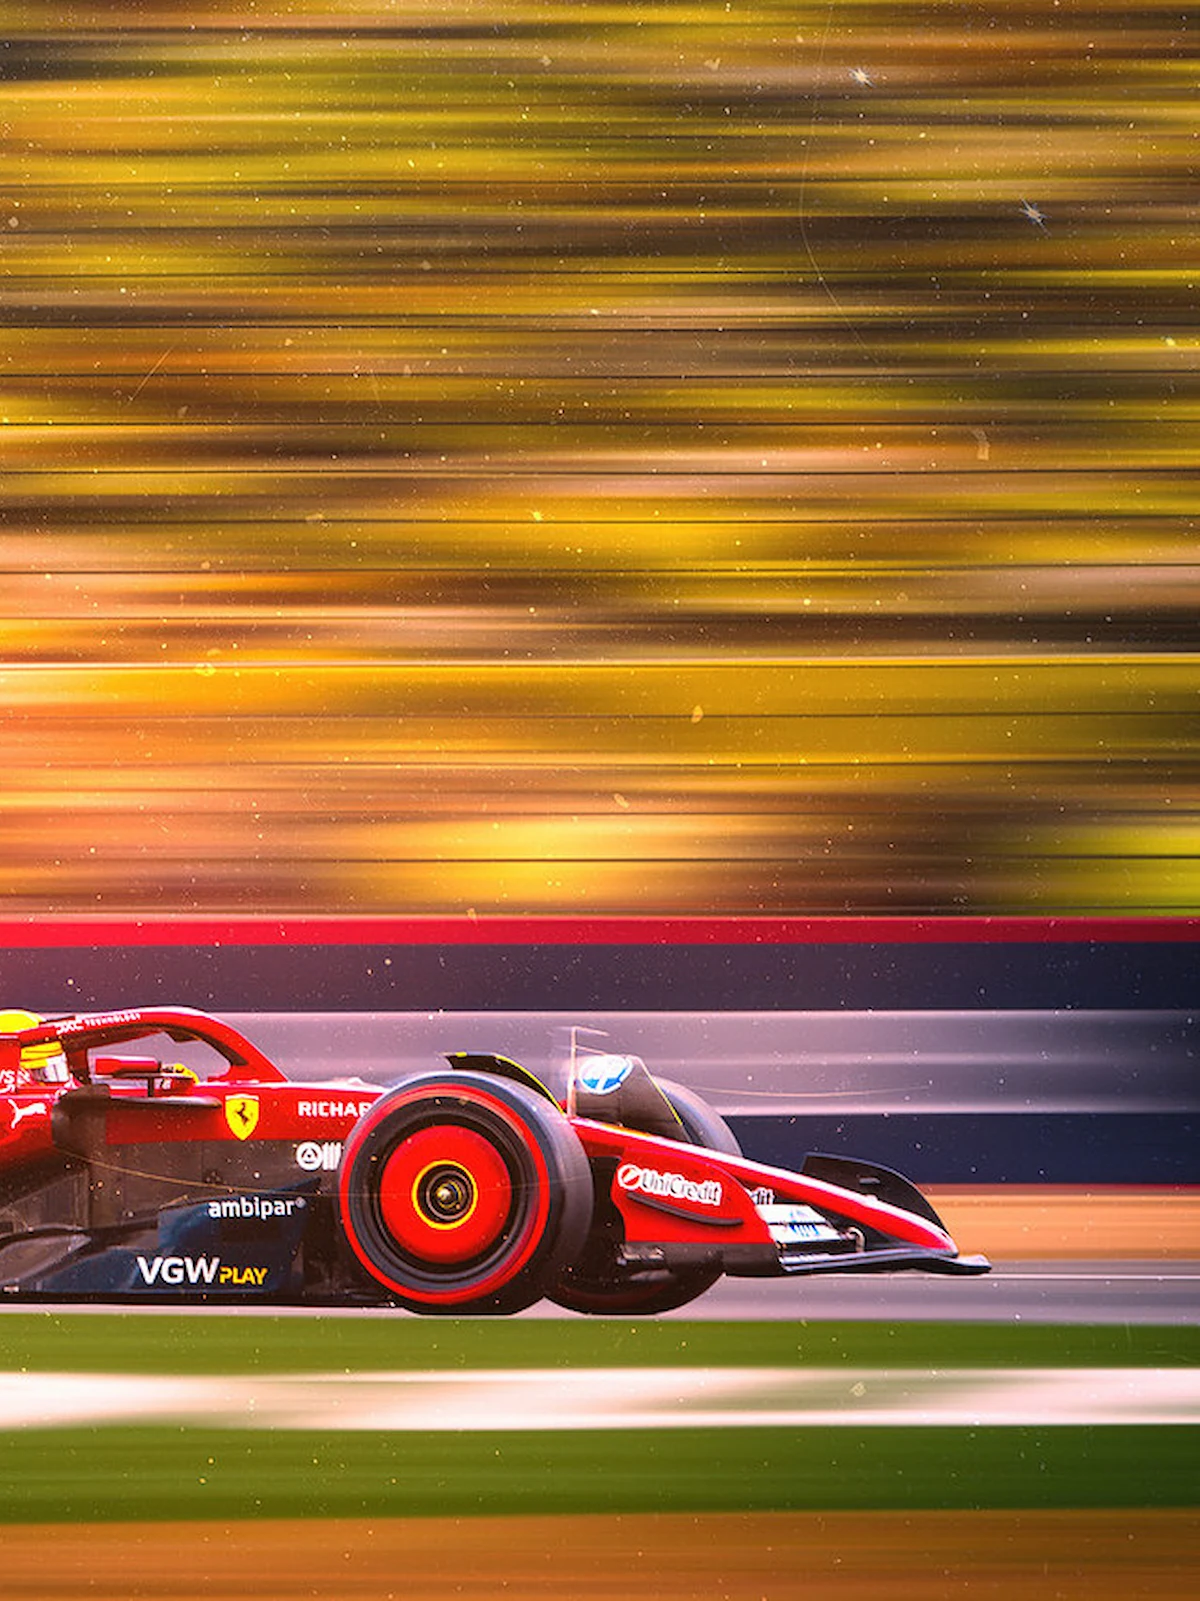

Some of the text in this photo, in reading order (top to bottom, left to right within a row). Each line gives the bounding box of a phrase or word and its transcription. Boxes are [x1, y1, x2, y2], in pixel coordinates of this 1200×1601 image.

[641, 1168, 722, 1206] UniCredit
[208, 1196, 296, 1220] ambipar
[220, 1266, 268, 1285] PLAY
